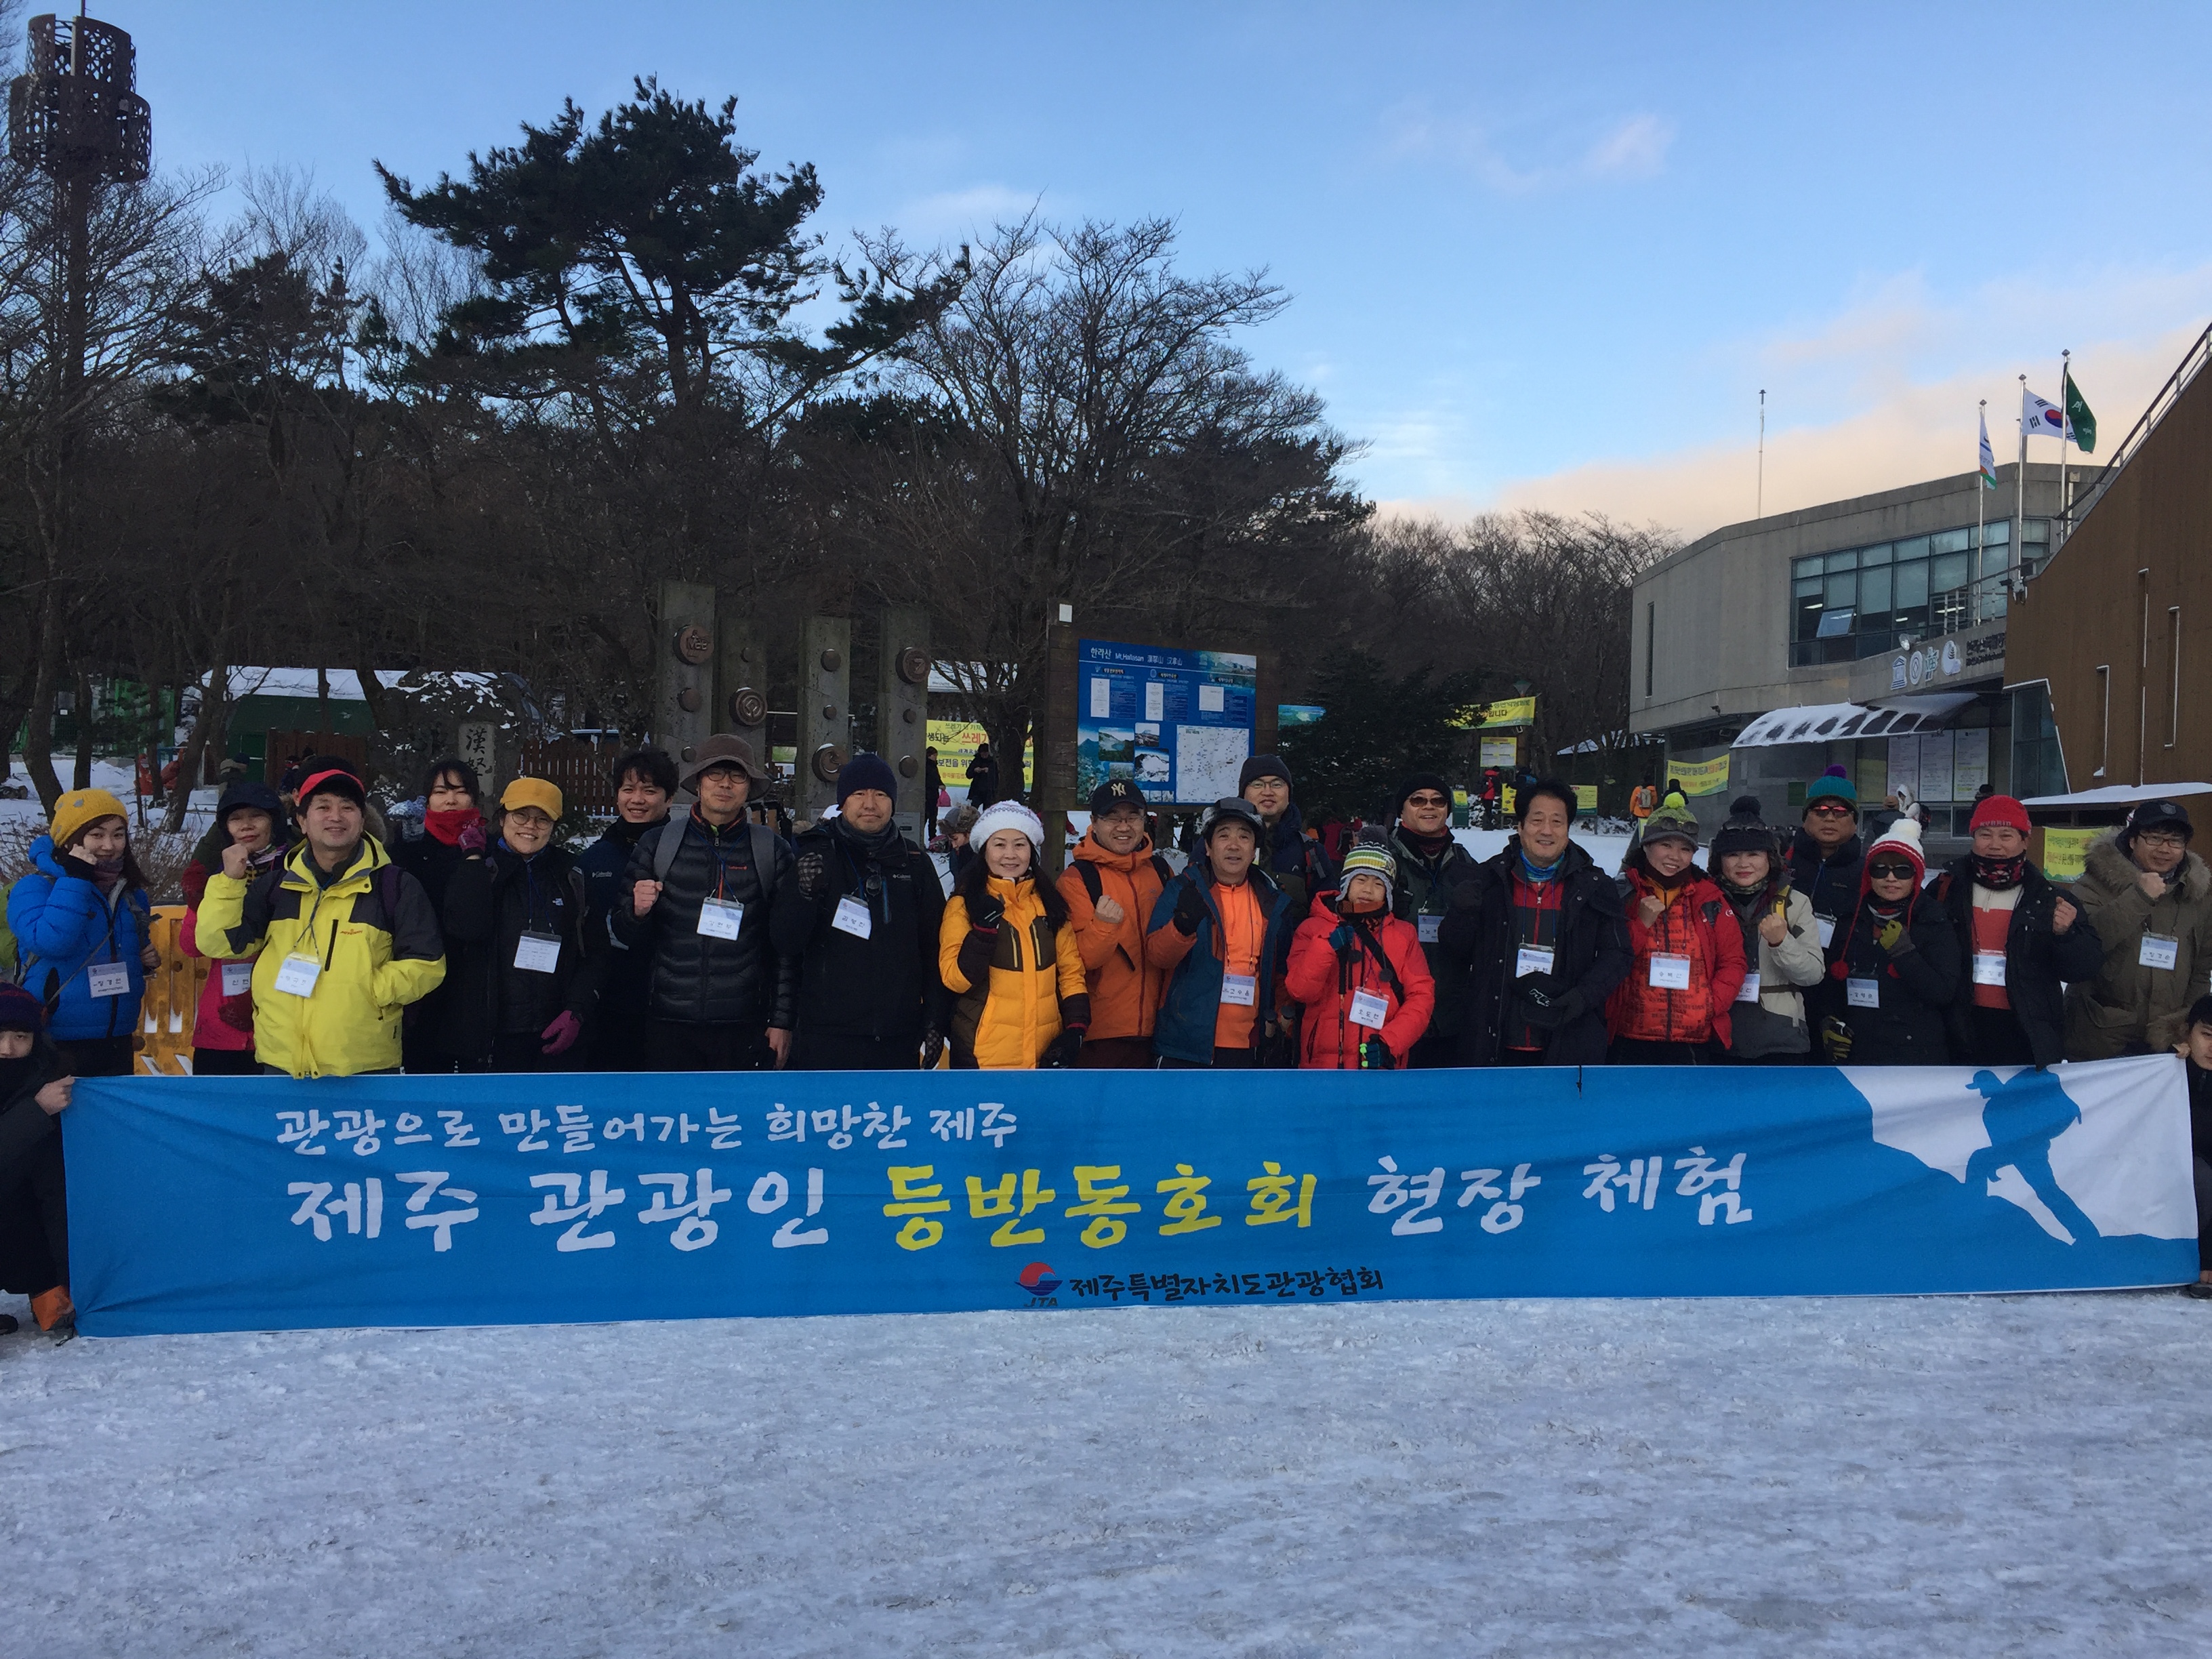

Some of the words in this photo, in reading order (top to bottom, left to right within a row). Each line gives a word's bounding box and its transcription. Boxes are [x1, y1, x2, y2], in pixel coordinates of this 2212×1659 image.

[1090, 647, 1111, 659] 한라산
[927, 733, 949, 742] 생되는
[936, 758, 959, 768] 보전을
[1111, 782, 1127, 797] NY
[276, 1109, 480, 1156] 관광으로
[498, 1105, 741, 1153] 만들어가는
[766, 1103, 911, 1150] 희망찬
[930, 1103, 1017, 1148] 제주
[287, 1171, 478, 1252] 제주
[529, 1169, 828, 1252] 관광인
[883, 1162, 1317, 1250] 등반동호회
[1367, 1155, 1541, 1235] 현장
[1582, 1146, 1753, 1225] 체험
[1069, 1266, 1383, 1302] 제주특별자치도관광협회
[1023, 1297, 1058, 1307] JTA
